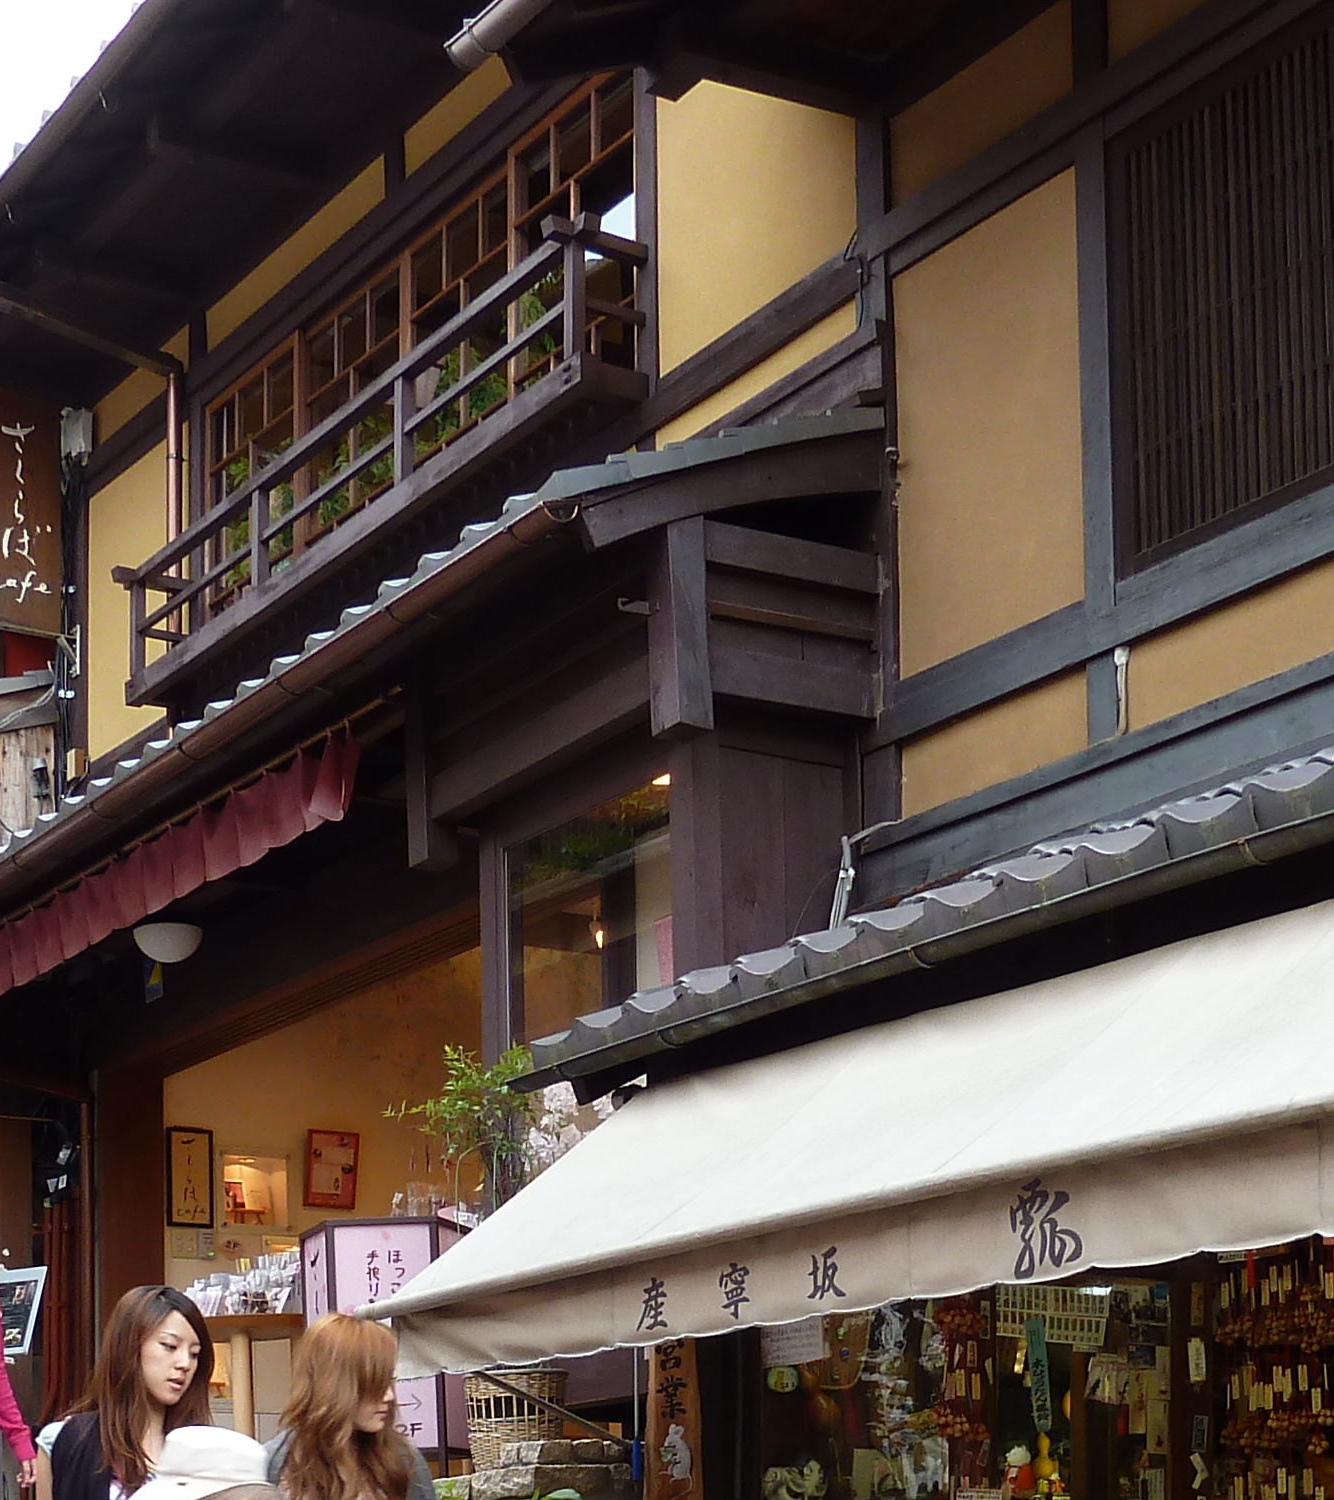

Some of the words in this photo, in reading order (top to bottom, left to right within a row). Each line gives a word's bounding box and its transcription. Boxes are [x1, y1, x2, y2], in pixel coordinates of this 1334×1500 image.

[1, 422, 51, 567] さくらば
[635, 1245, 847, 1333] 産寧坂
